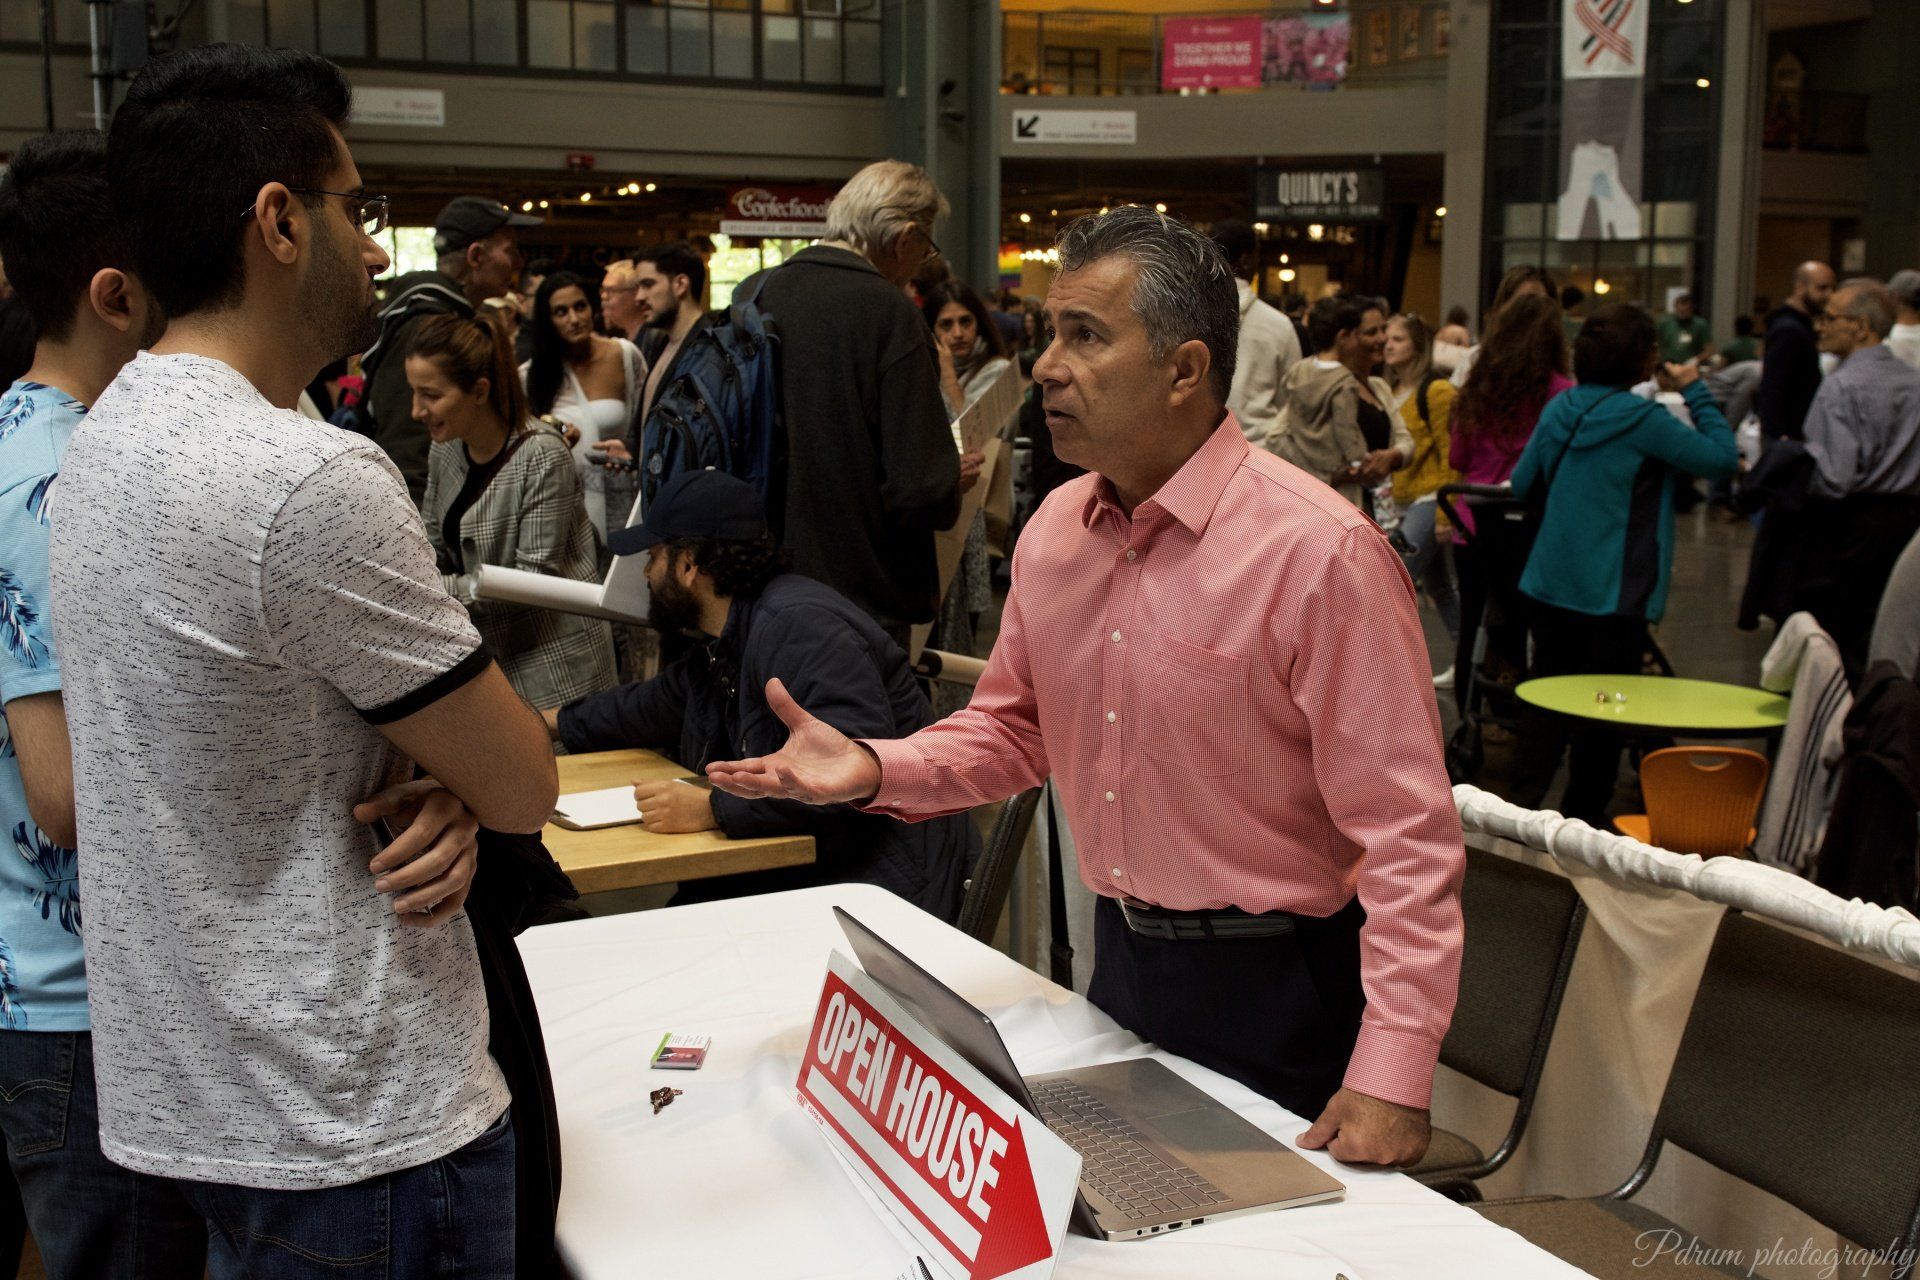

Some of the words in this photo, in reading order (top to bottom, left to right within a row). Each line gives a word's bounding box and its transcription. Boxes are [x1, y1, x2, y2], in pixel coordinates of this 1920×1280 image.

[1212, 54, 1252, 67] PROUD
[1278, 171, 1358, 206] QUINCY'S
[817, 991, 895, 1117] OPEN
[885, 1054, 1008, 1223] HOUSE
